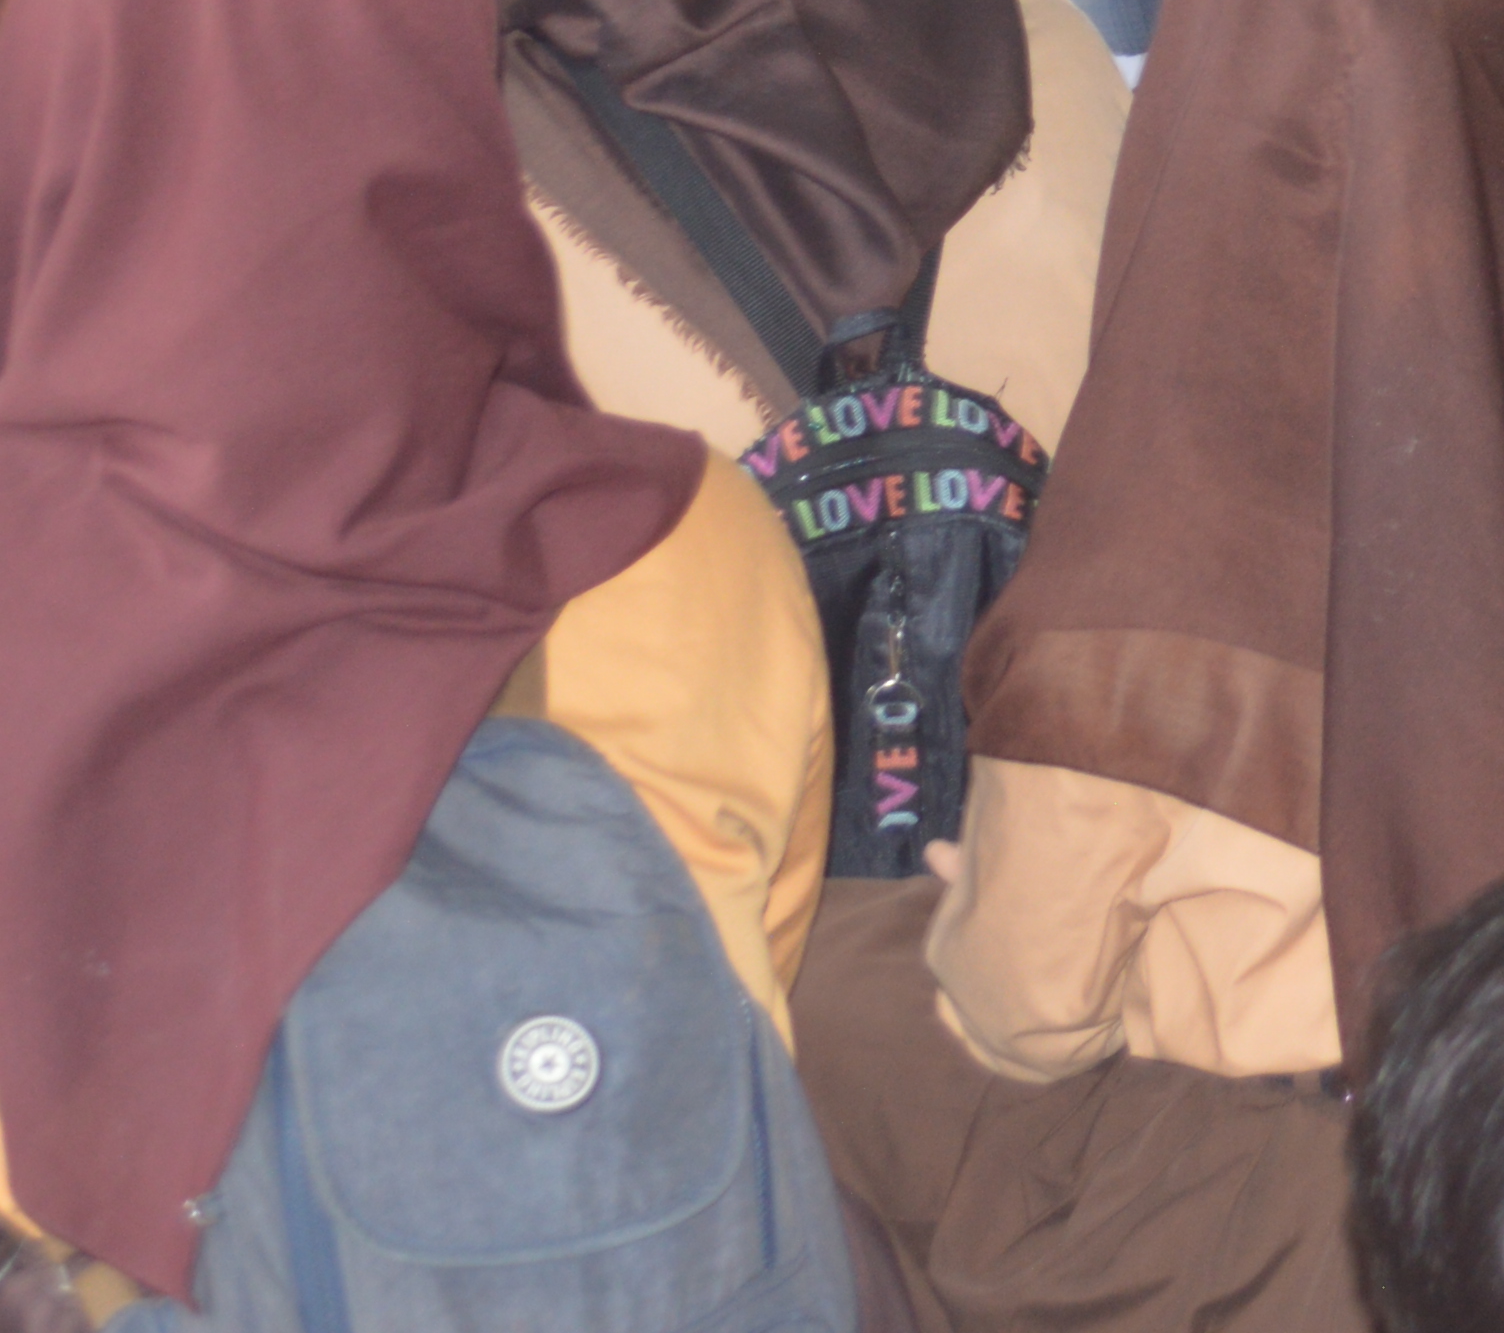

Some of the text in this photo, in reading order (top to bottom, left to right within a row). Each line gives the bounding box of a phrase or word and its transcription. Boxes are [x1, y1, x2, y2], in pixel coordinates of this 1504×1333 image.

[747, 386, 1040, 478] VE LOVE LOVE
[793, 468, 1026, 540] LOVE LOVE
